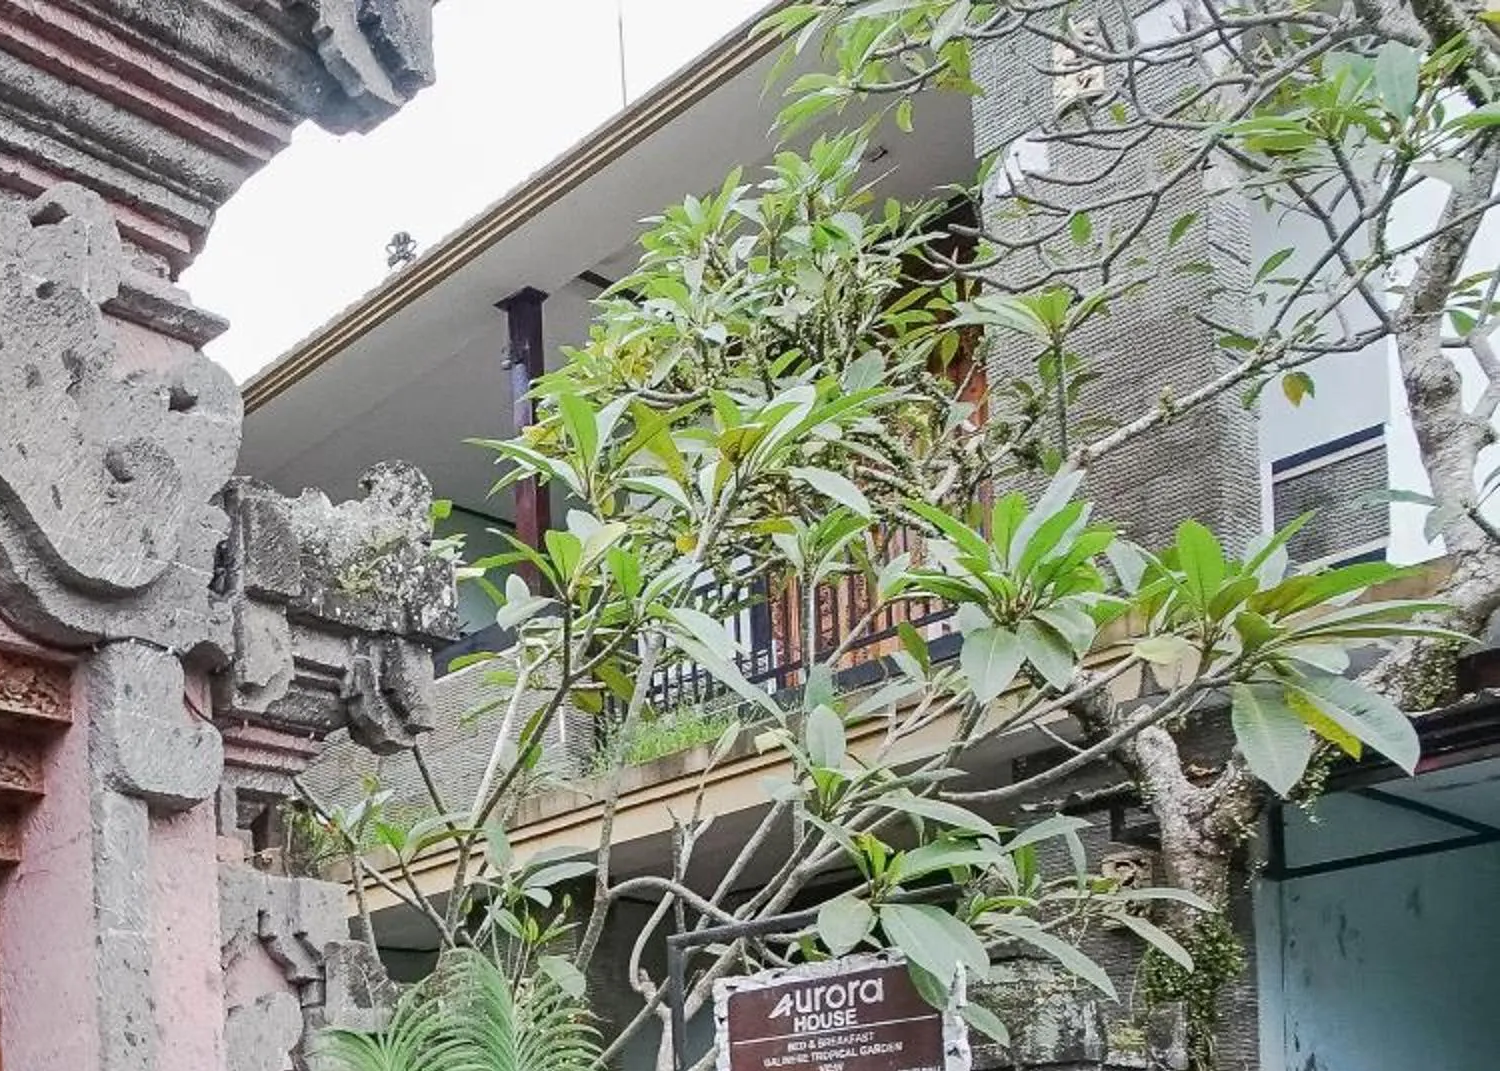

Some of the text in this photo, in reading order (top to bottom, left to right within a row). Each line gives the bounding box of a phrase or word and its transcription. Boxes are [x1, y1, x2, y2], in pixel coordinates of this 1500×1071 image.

[768, 977, 884, 1019] Aurora
[794, 1008, 858, 1032] HOUSE
[808, 1039, 816, 1049] &
[818, 1032, 875, 1048] BREAKFAST
[811, 1048, 858, 1061] TROPICAL
[860, 1042, 903, 1055] GARDEN
